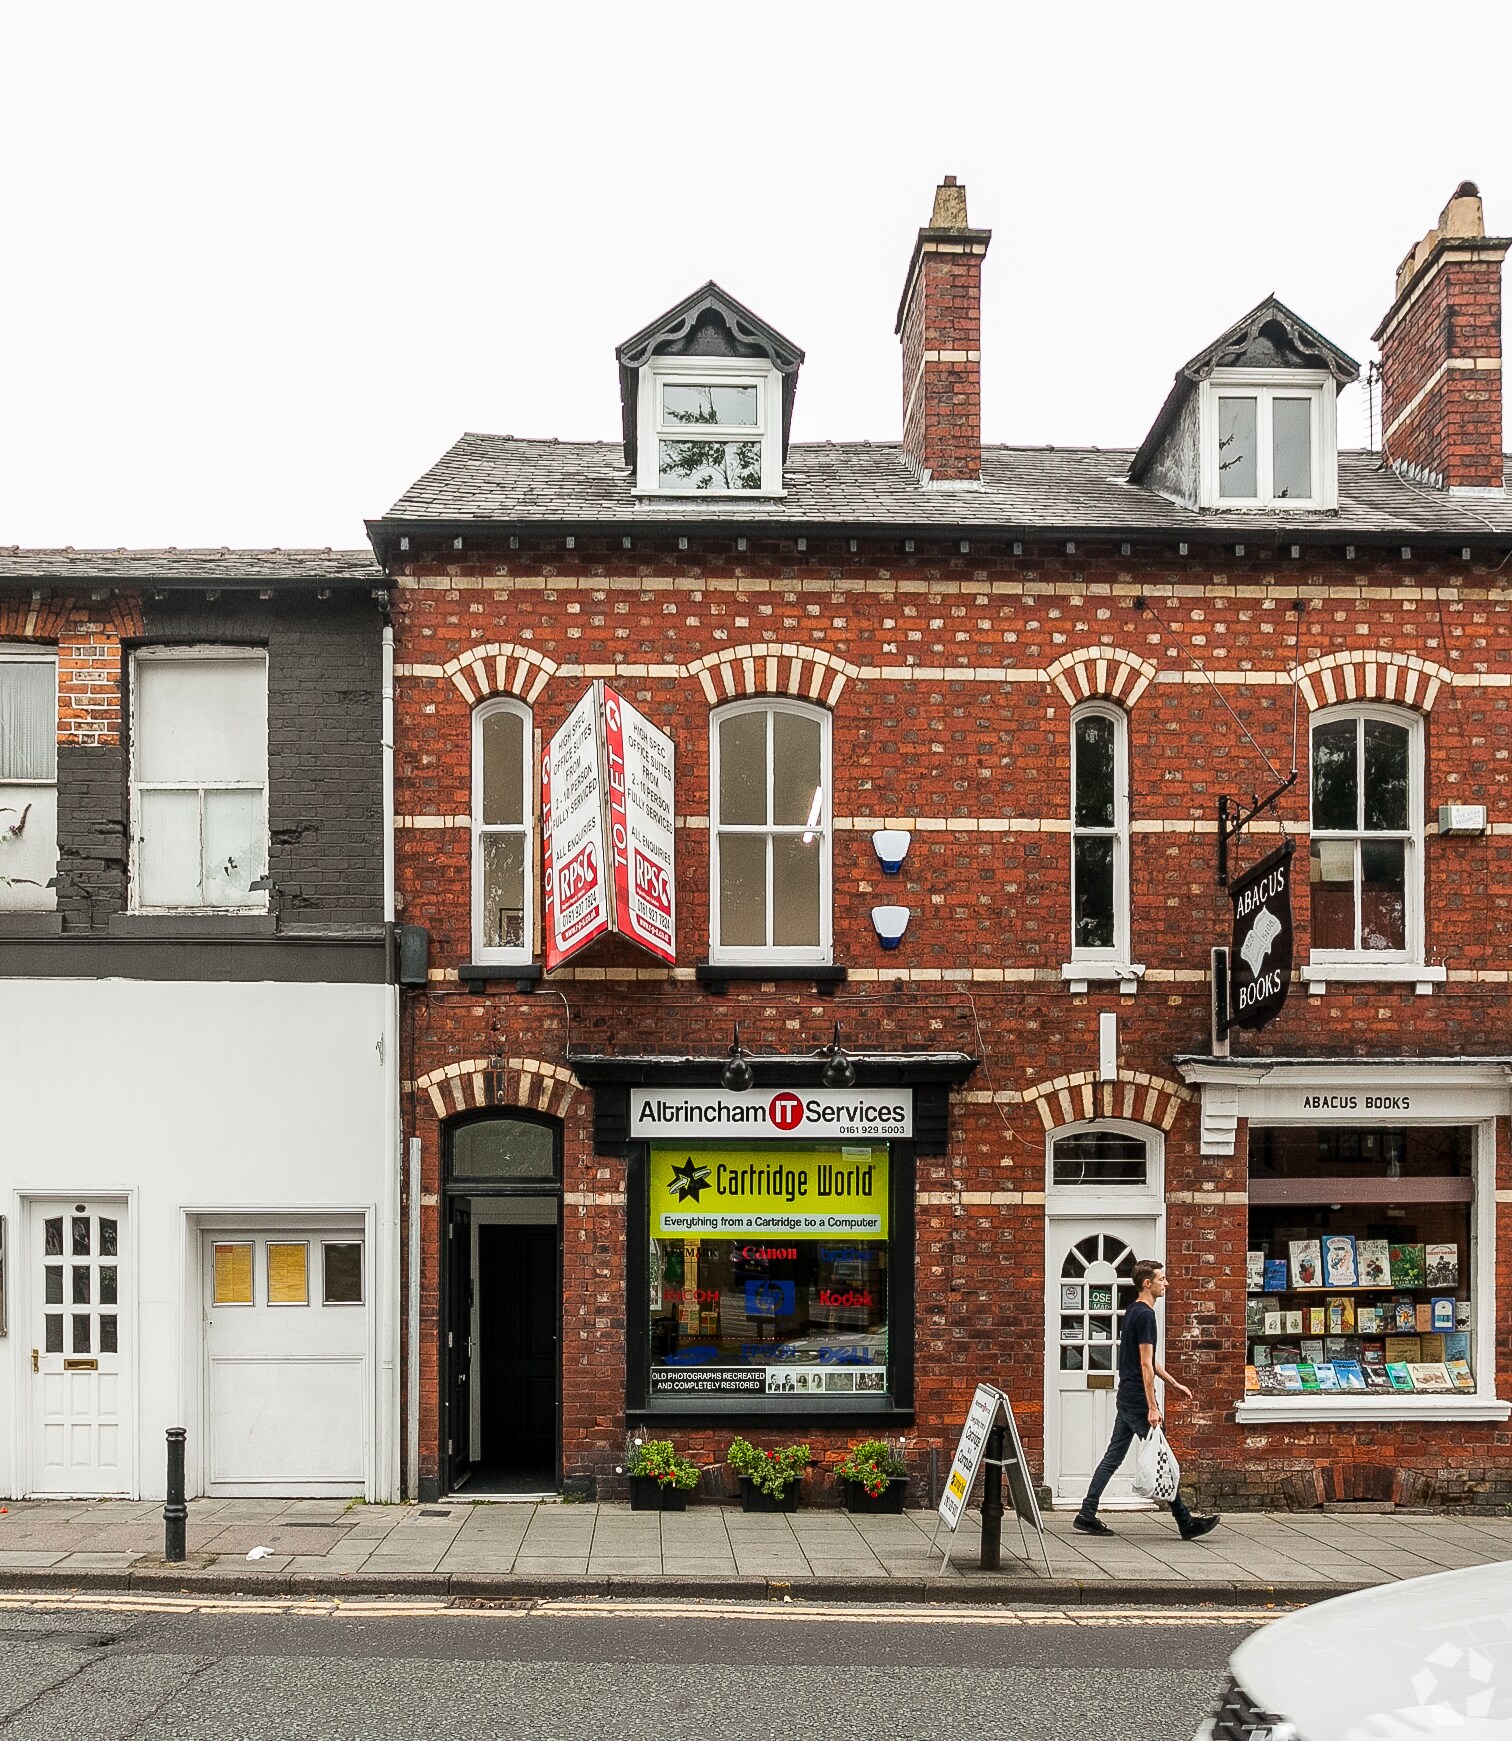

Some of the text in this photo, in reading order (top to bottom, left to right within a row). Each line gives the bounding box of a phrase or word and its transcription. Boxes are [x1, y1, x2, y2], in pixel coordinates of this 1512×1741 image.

[558, 711, 586, 753] HIGH SPEC
[633, 721, 666, 759] HIGH SPEC
[553, 723, 592, 776] OFFICE SUITES
[628, 735, 672, 782] OFFICE SUITES
[565, 755, 581, 782] FROM
[571, 761, 593, 795] PERSON
[642, 764, 659, 788] FROM
[553, 777, 598, 831] FULLY SERVICED
[609, 744, 627, 868] TO LET
[627, 787, 673, 835] FULLY SERVICED
[646, 787, 671, 816] PERSON
[556, 816, 596, 862] ALL ENQUIRIES
[631, 826, 671, 866] ALL ENQUIRIES
[543, 802, 554, 913] TO LET
[1236, 867, 1285, 919] ABACUS
[562, 911, 575, 928] 0161
[575, 904, 584, 919] 927
[637, 898, 647, 916] 0161
[648, 907, 658, 923] 927
[1244, 933, 1255, 953] 928
[1239, 969, 1281, 1010] BOOKS
[639, 1100, 905, 1123] Altrincham IT Services
[1303, 1096, 1410, 1109] ABACUS BOOKS
[839, 1126, 905, 1134] 0161 929 5003
[716, 1164, 873, 1202] Cartridge World
[664, 1216, 878, 1230] Everything from a Cartridge to a Computer
[742, 1246, 798, 1260] Canon
[664, 1289, 719, 1302] RICOH
[819, 1290, 873, 1307] Kodak
[651, 1372, 765, 1380] OLD PHOTOGRAPHS RECREATED
[657, 1381, 760, 1390] AND COMPLETELY RESTORED
